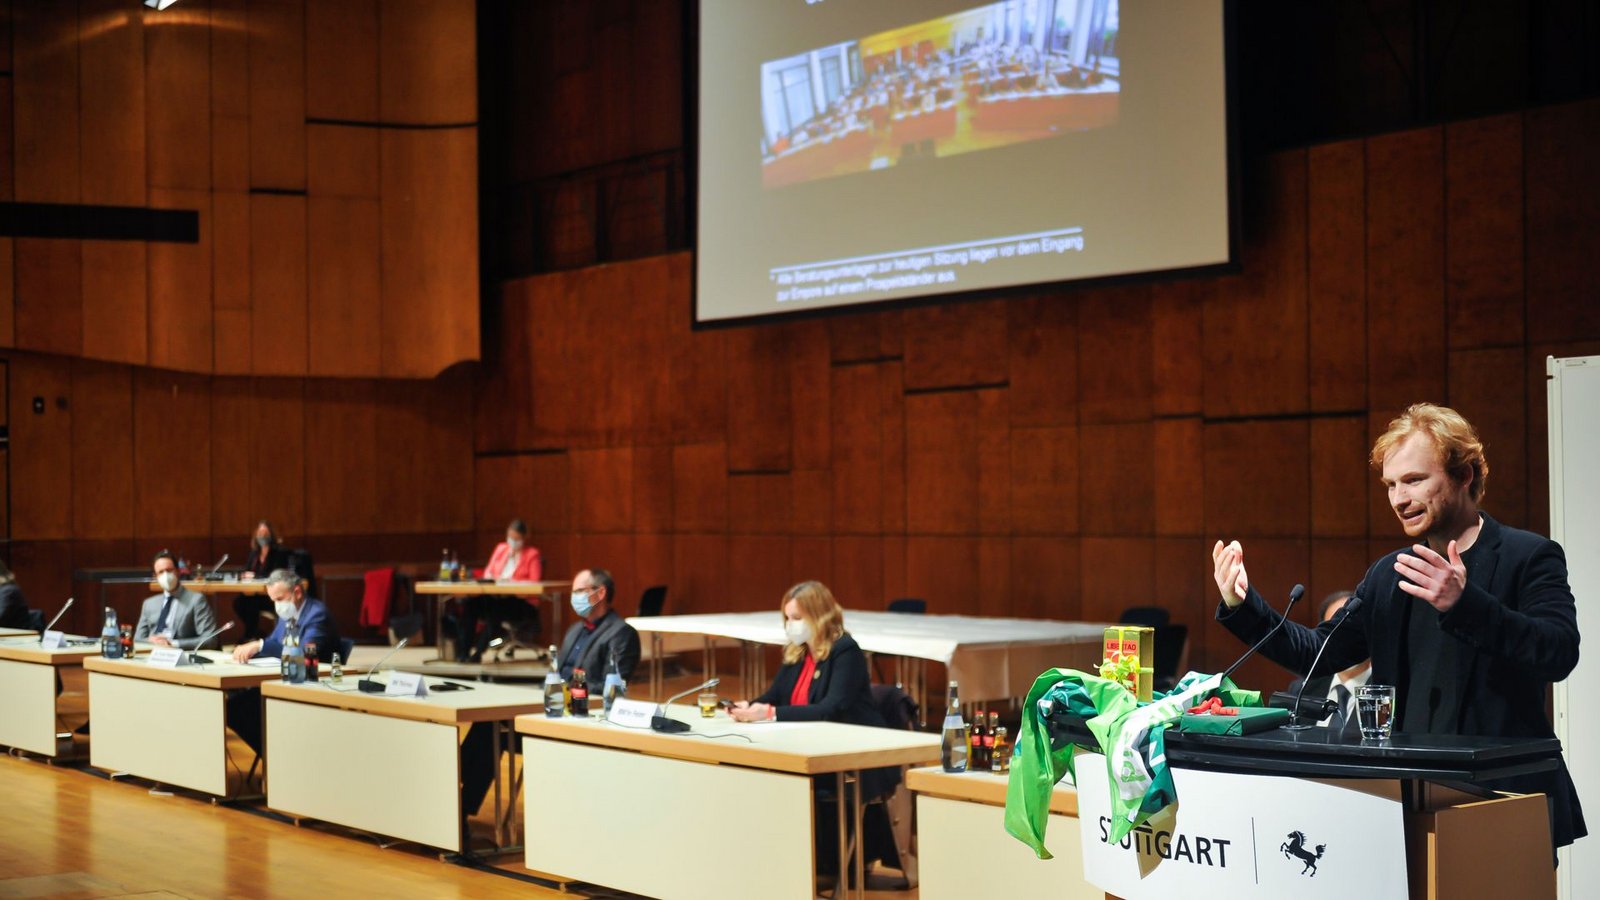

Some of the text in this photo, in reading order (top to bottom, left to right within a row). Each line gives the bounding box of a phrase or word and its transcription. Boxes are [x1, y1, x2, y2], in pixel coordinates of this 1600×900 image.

[1000, 244, 1016, 257] vor
[1017, 240, 1040, 256] dem
[1041, 236, 1084, 254] Eingang
[1099, 815, 1231, 868] SUTTGART
